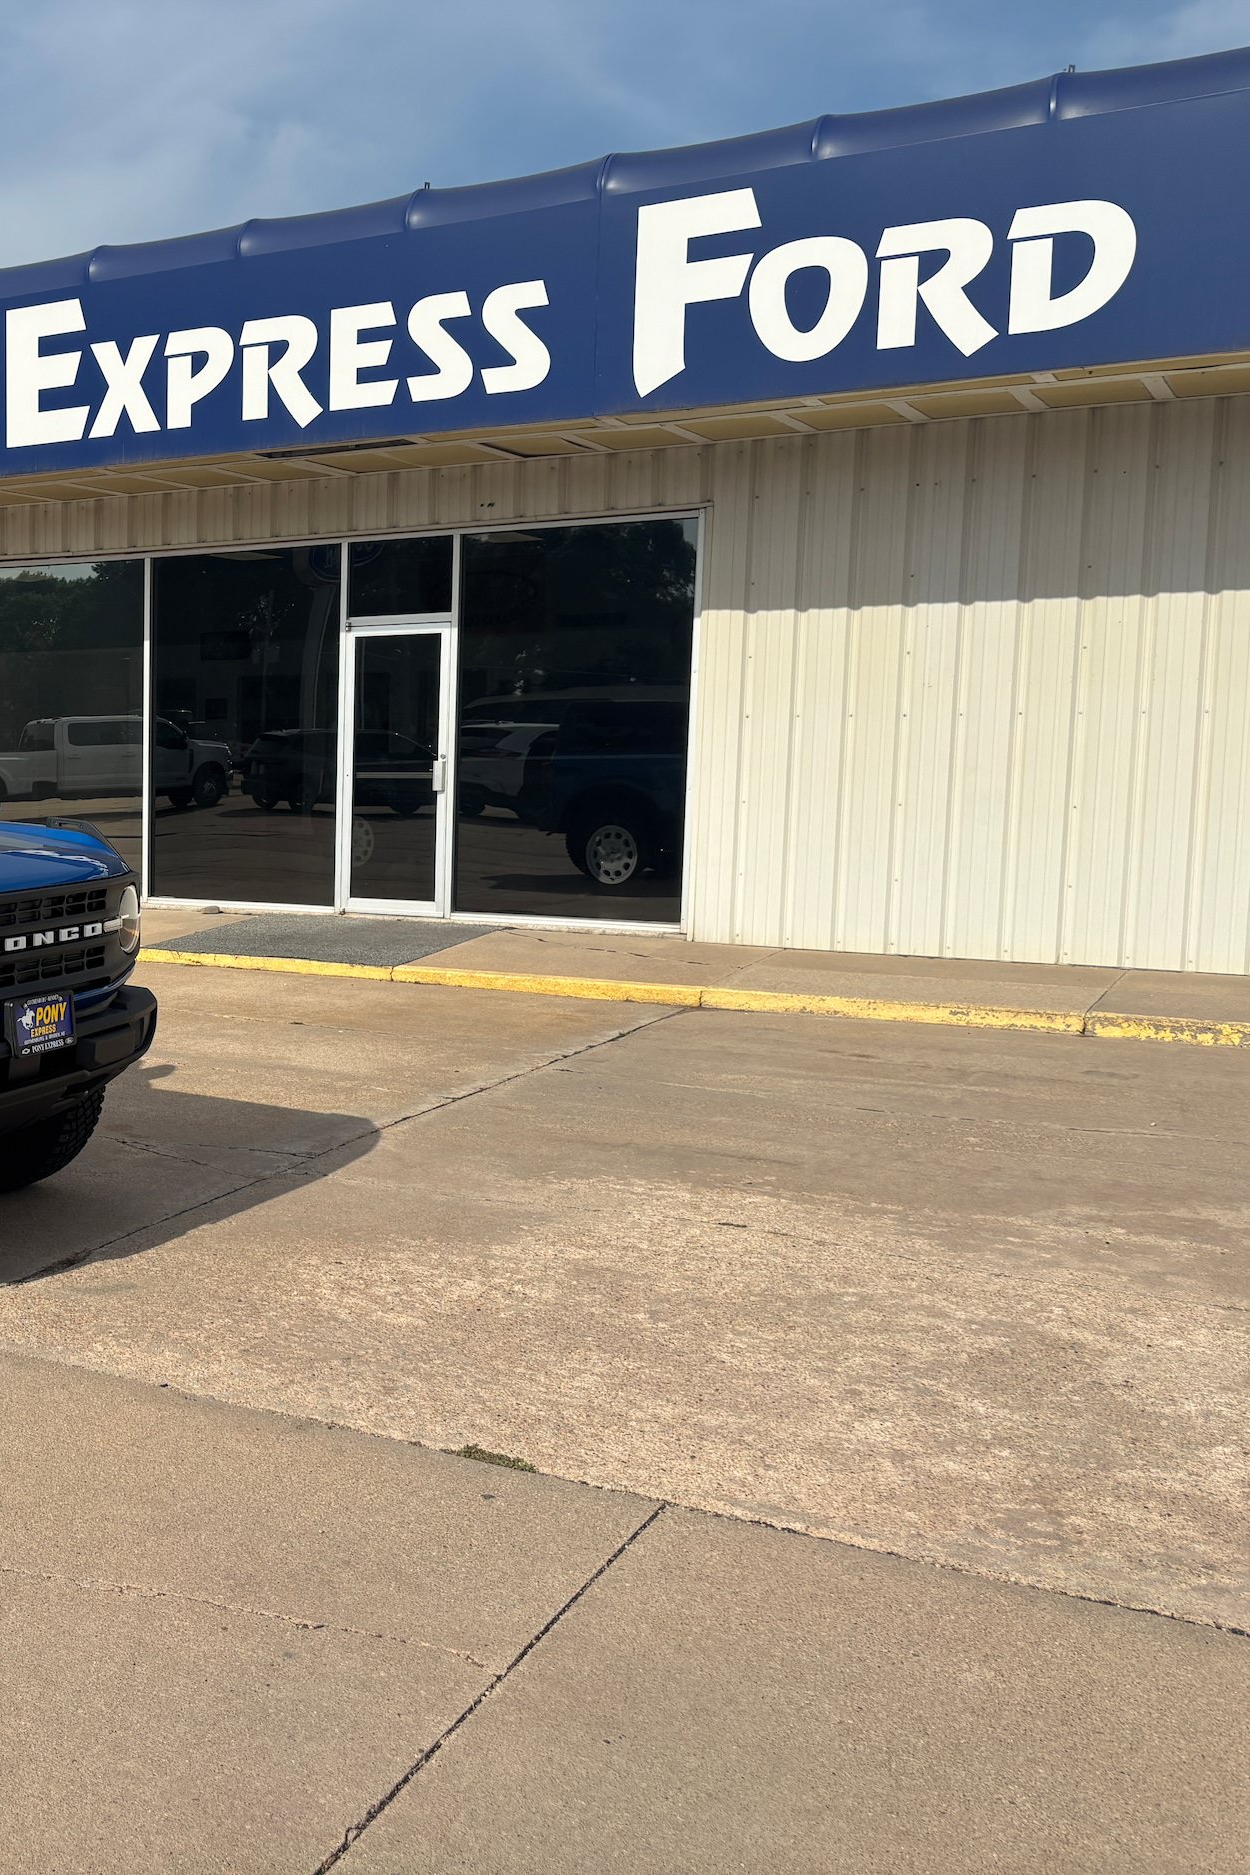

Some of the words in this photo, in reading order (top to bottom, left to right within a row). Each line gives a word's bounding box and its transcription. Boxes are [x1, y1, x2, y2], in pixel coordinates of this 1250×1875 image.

[5, 279, 551, 449] EXPRESS
[632, 187, 1137, 398] FORD
[36, 1002, 67, 1026] PONY
[31, 1024, 56, 1038] EXPRESS
